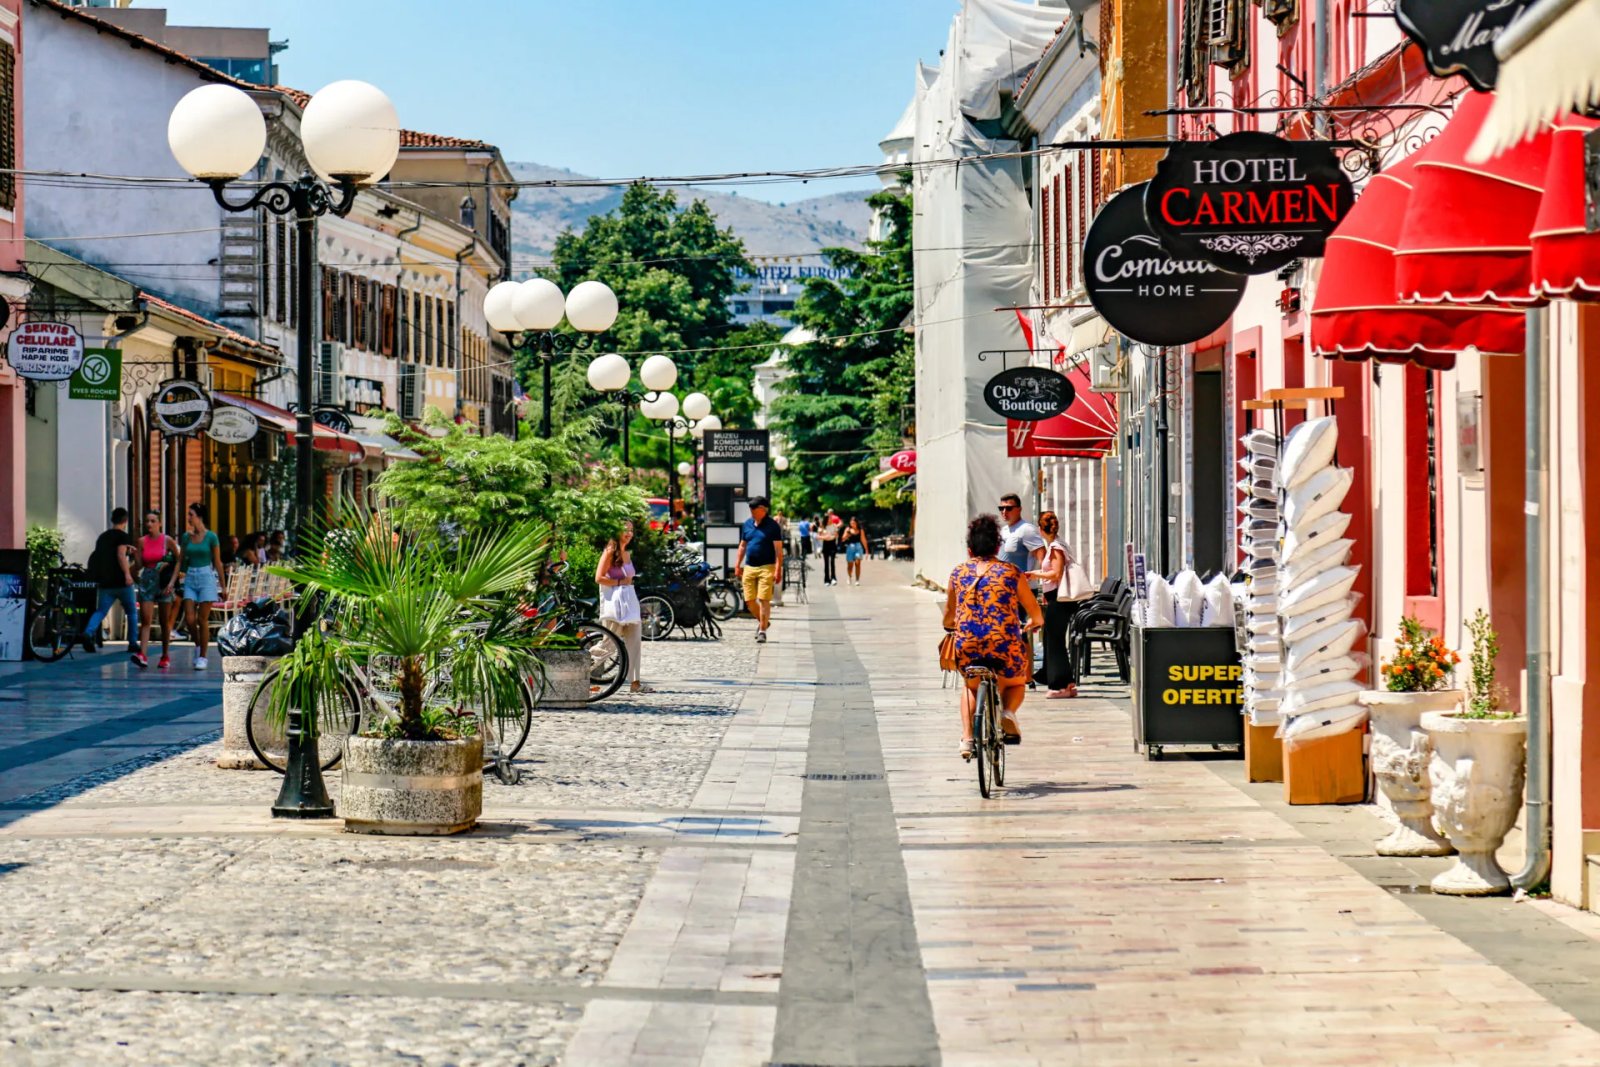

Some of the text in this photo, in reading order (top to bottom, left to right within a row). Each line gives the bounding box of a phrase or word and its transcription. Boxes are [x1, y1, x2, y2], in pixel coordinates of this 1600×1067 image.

[1193, 158, 1306, 184] HOTEL
[1160, 184, 1340, 226] CARMEN
[1138, 285, 1195, 297] HOME
[24, 324, 69, 335] SERVIS
[16, 335, 76, 346] CELULARË
[992, 385, 1020, 399] City
[998, 399, 1058, 413] Boutique
[1168, 665, 1243, 681] SUPER
